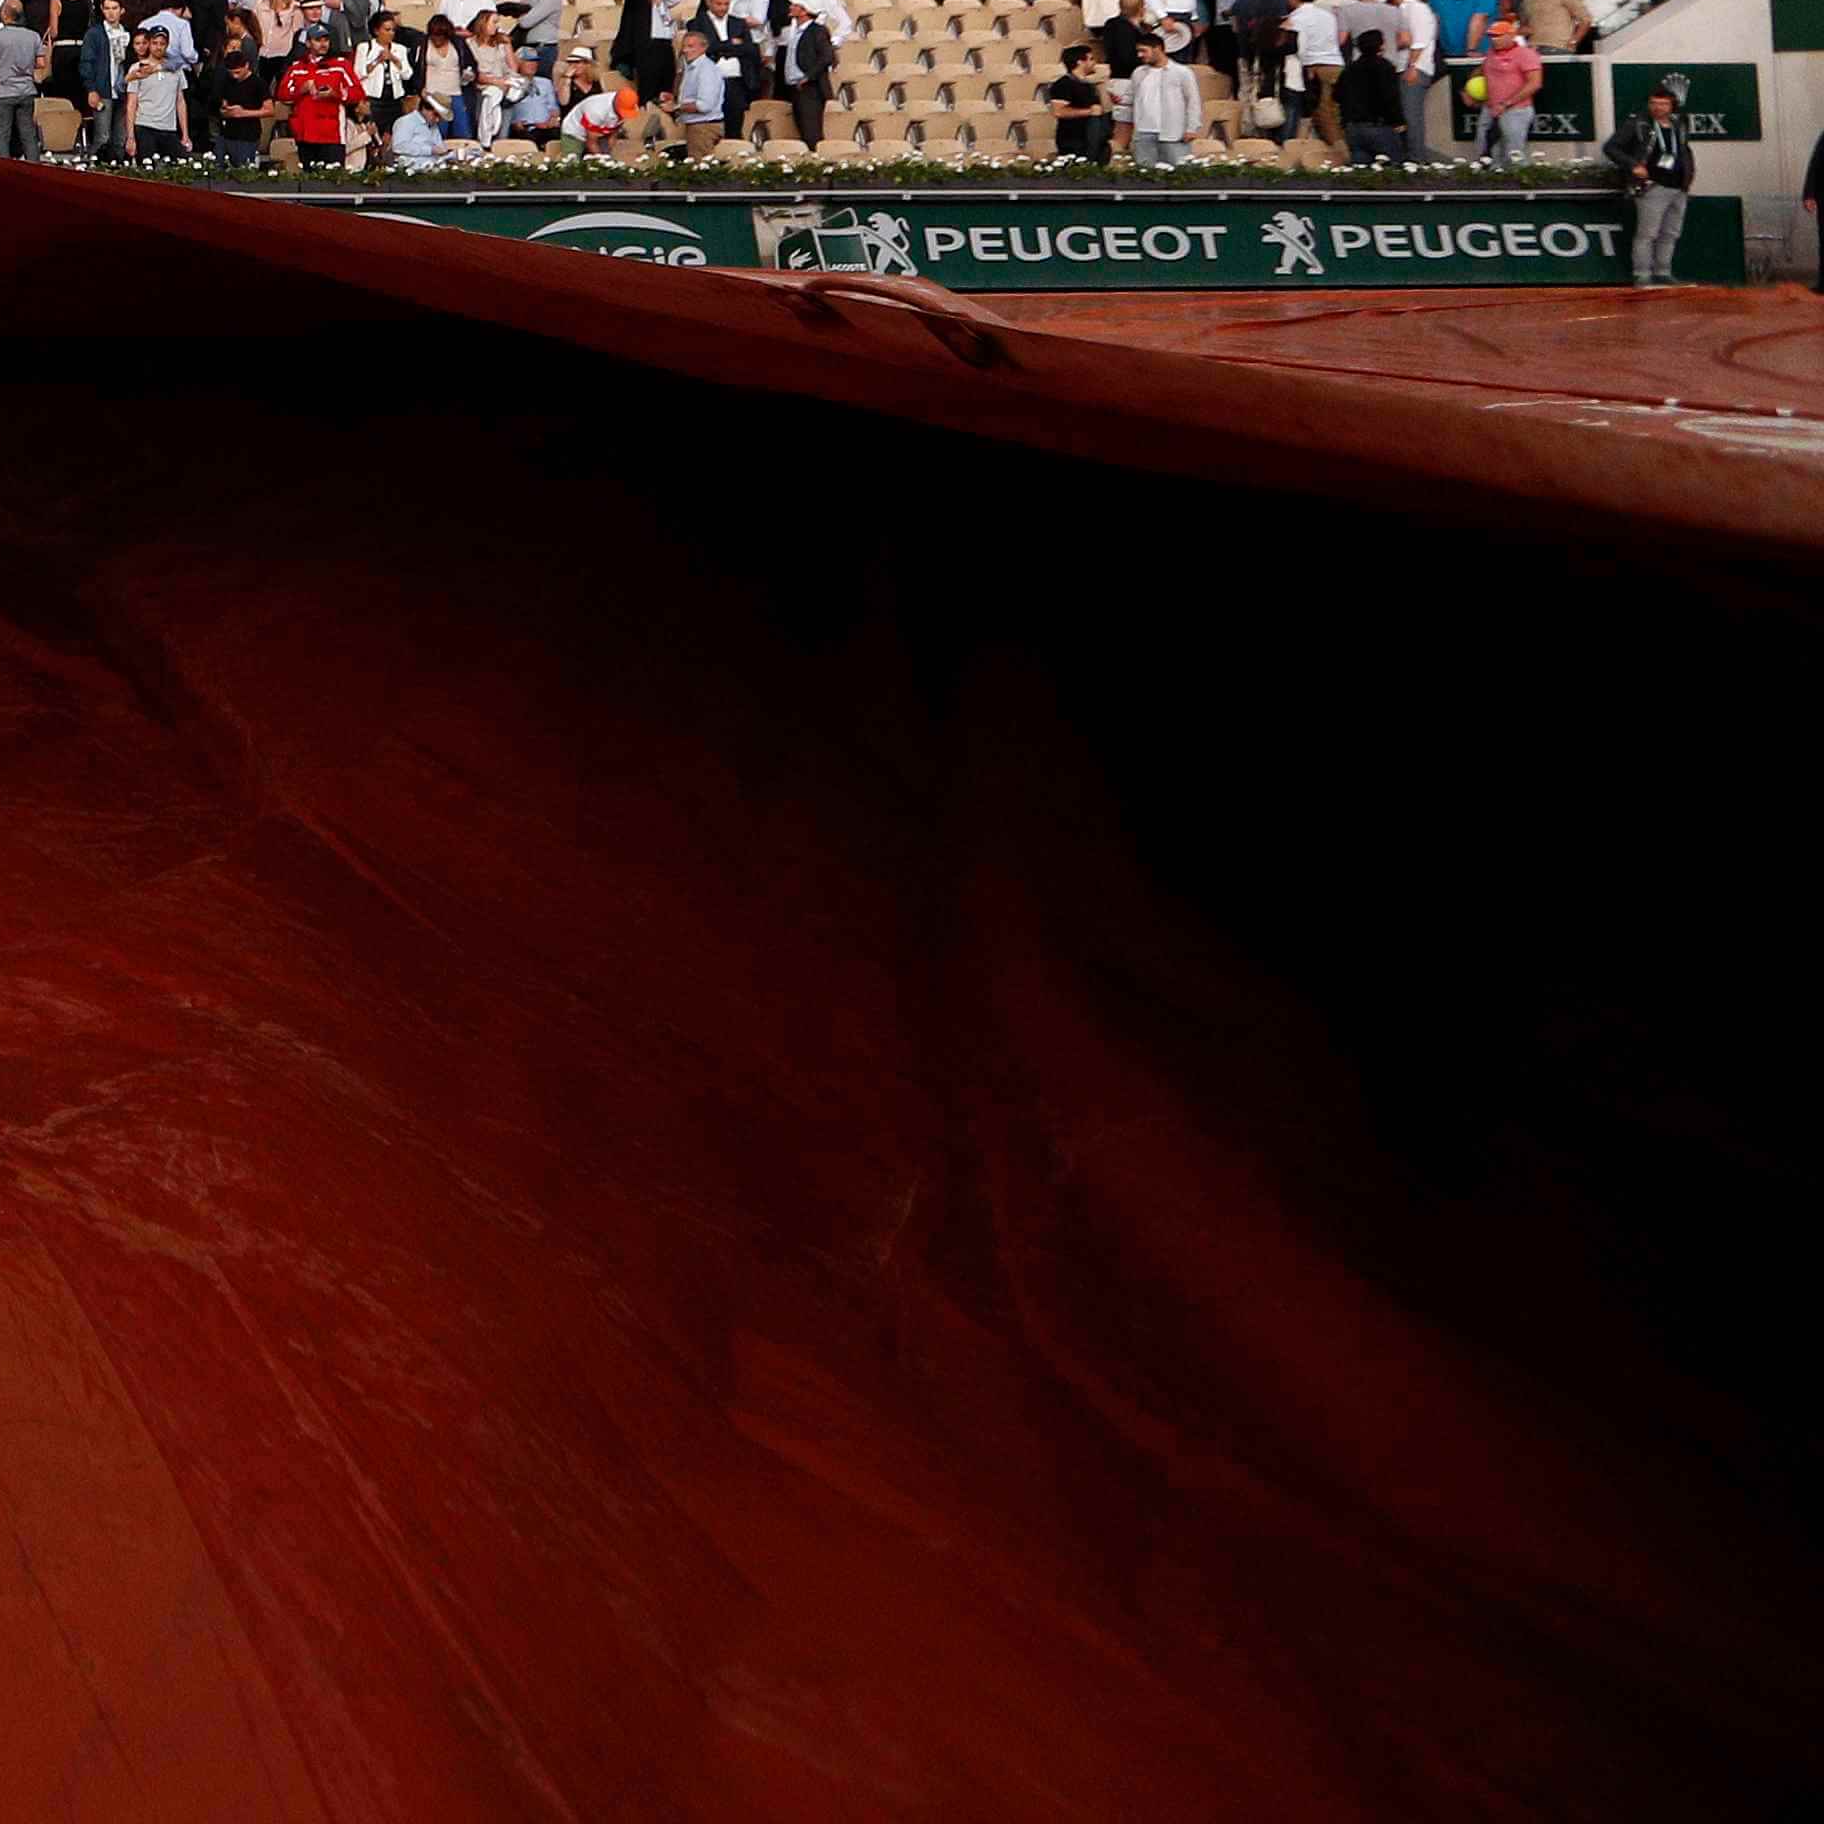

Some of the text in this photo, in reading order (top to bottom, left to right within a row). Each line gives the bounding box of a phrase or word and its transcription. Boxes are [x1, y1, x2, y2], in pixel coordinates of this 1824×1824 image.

[1464, 113, 1581, 135] REX
[924, 225, 1228, 262] PEUGEOT
[1331, 222, 1623, 259] PEUGEOT
